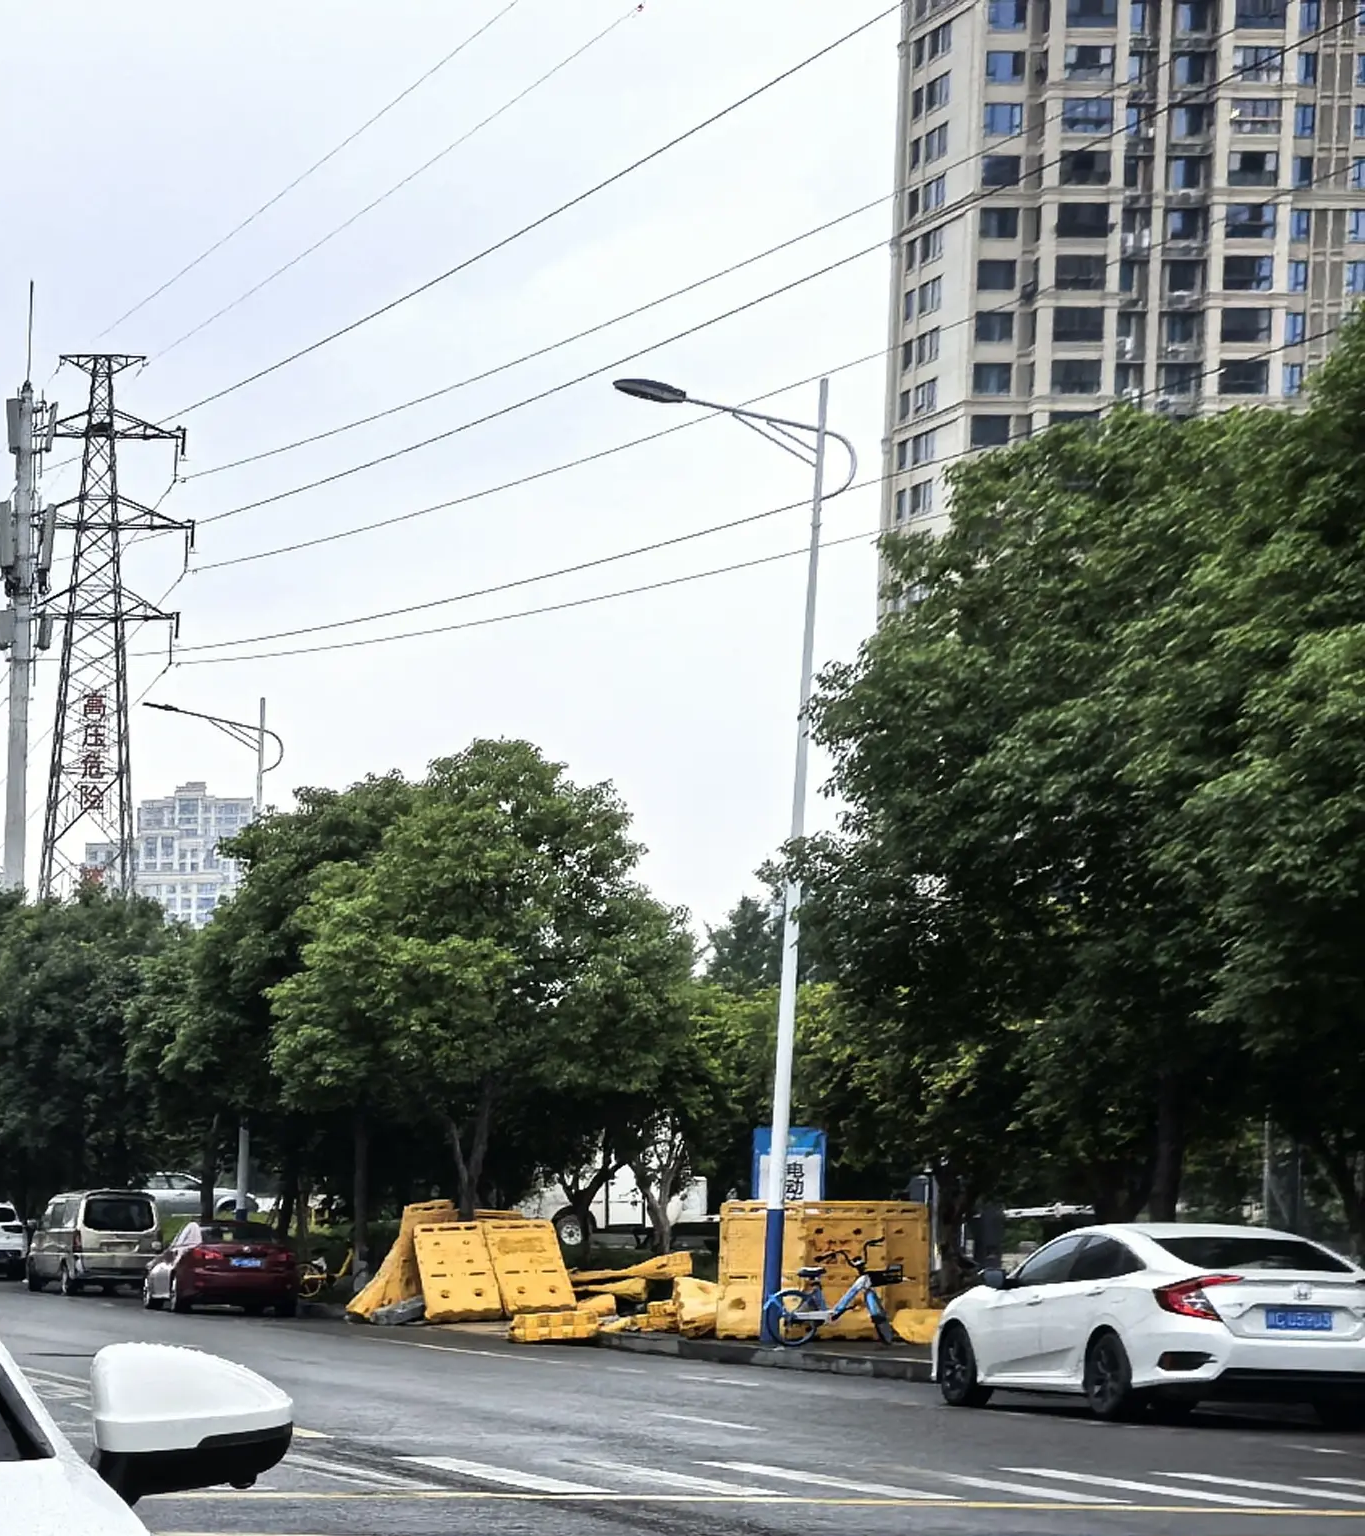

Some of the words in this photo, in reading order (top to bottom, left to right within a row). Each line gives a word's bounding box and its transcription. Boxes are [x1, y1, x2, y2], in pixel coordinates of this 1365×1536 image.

[81, 690, 107, 811] 高压危险
[784, 1161, 805, 1200] 电动
